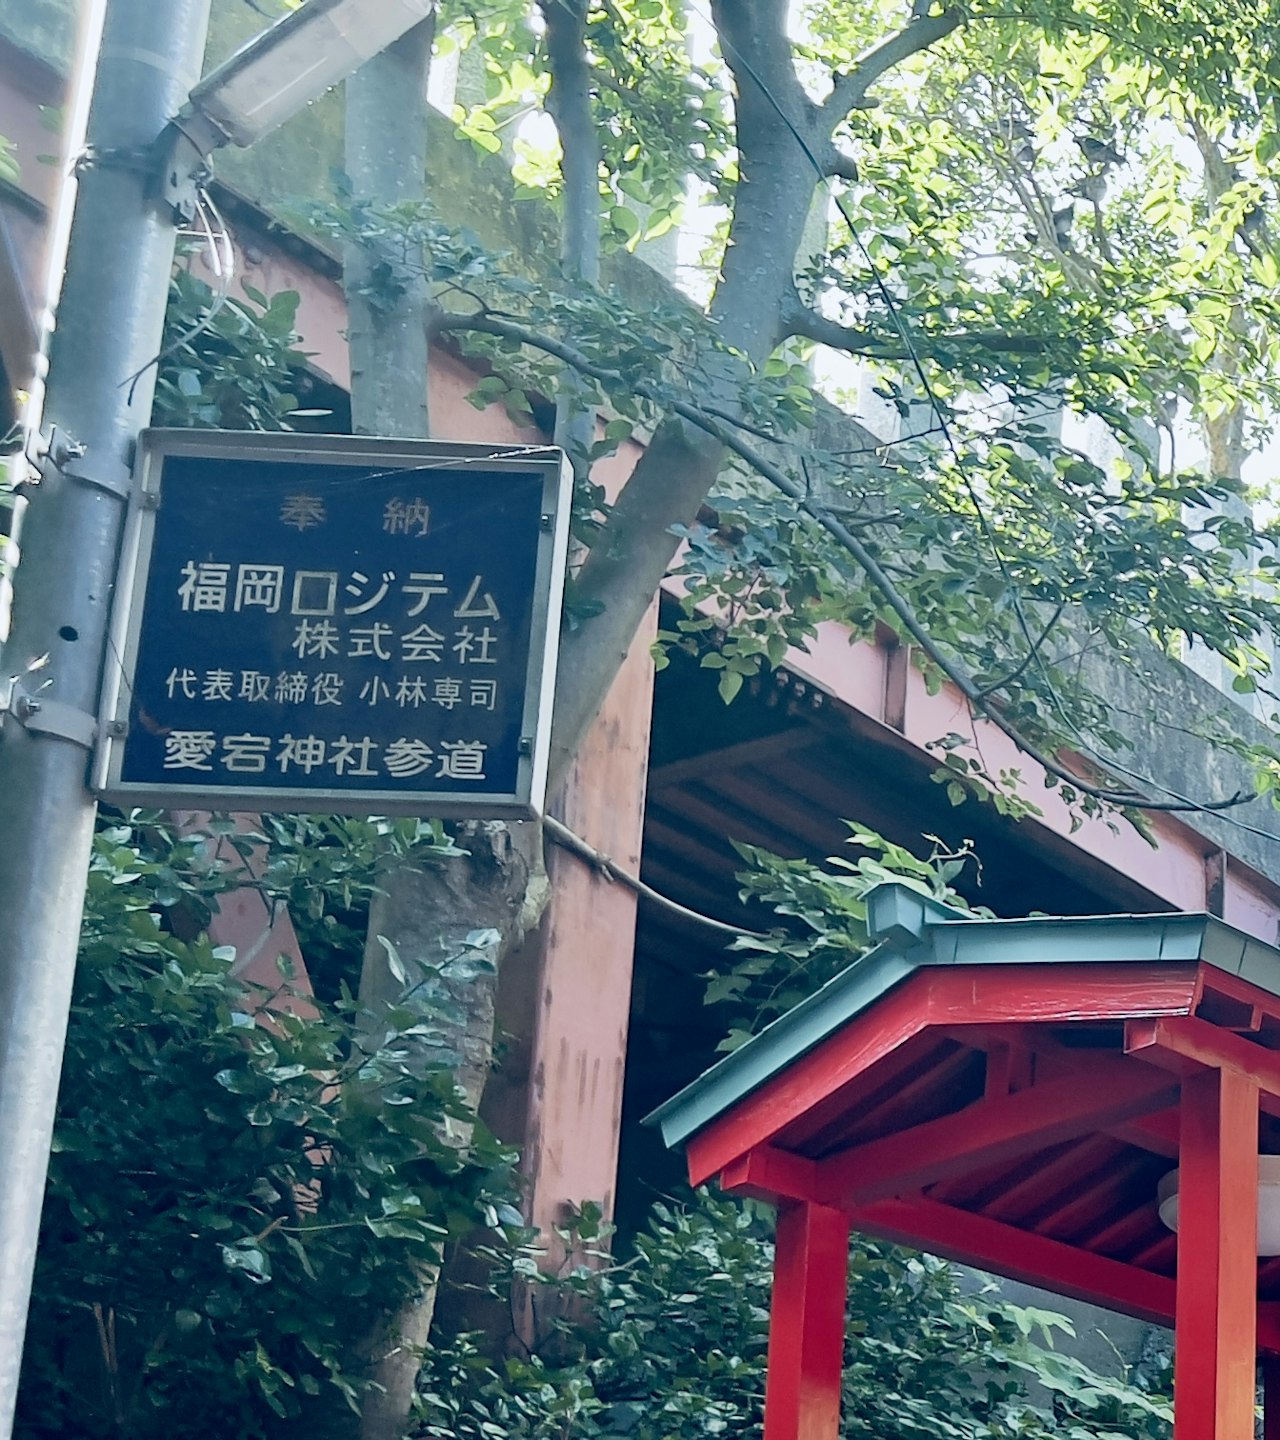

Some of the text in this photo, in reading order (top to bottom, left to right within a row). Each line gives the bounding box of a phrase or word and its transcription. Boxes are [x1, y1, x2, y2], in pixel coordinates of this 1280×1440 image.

[279, 495, 431, 537] 奉納
[177, 560, 500, 621] 福岡ロジテム
[292, 619, 498, 665] 株式会社
[165, 666, 498, 710] 代表取締役 小林専司
[163, 731, 487, 780] 愛宕神社参道
